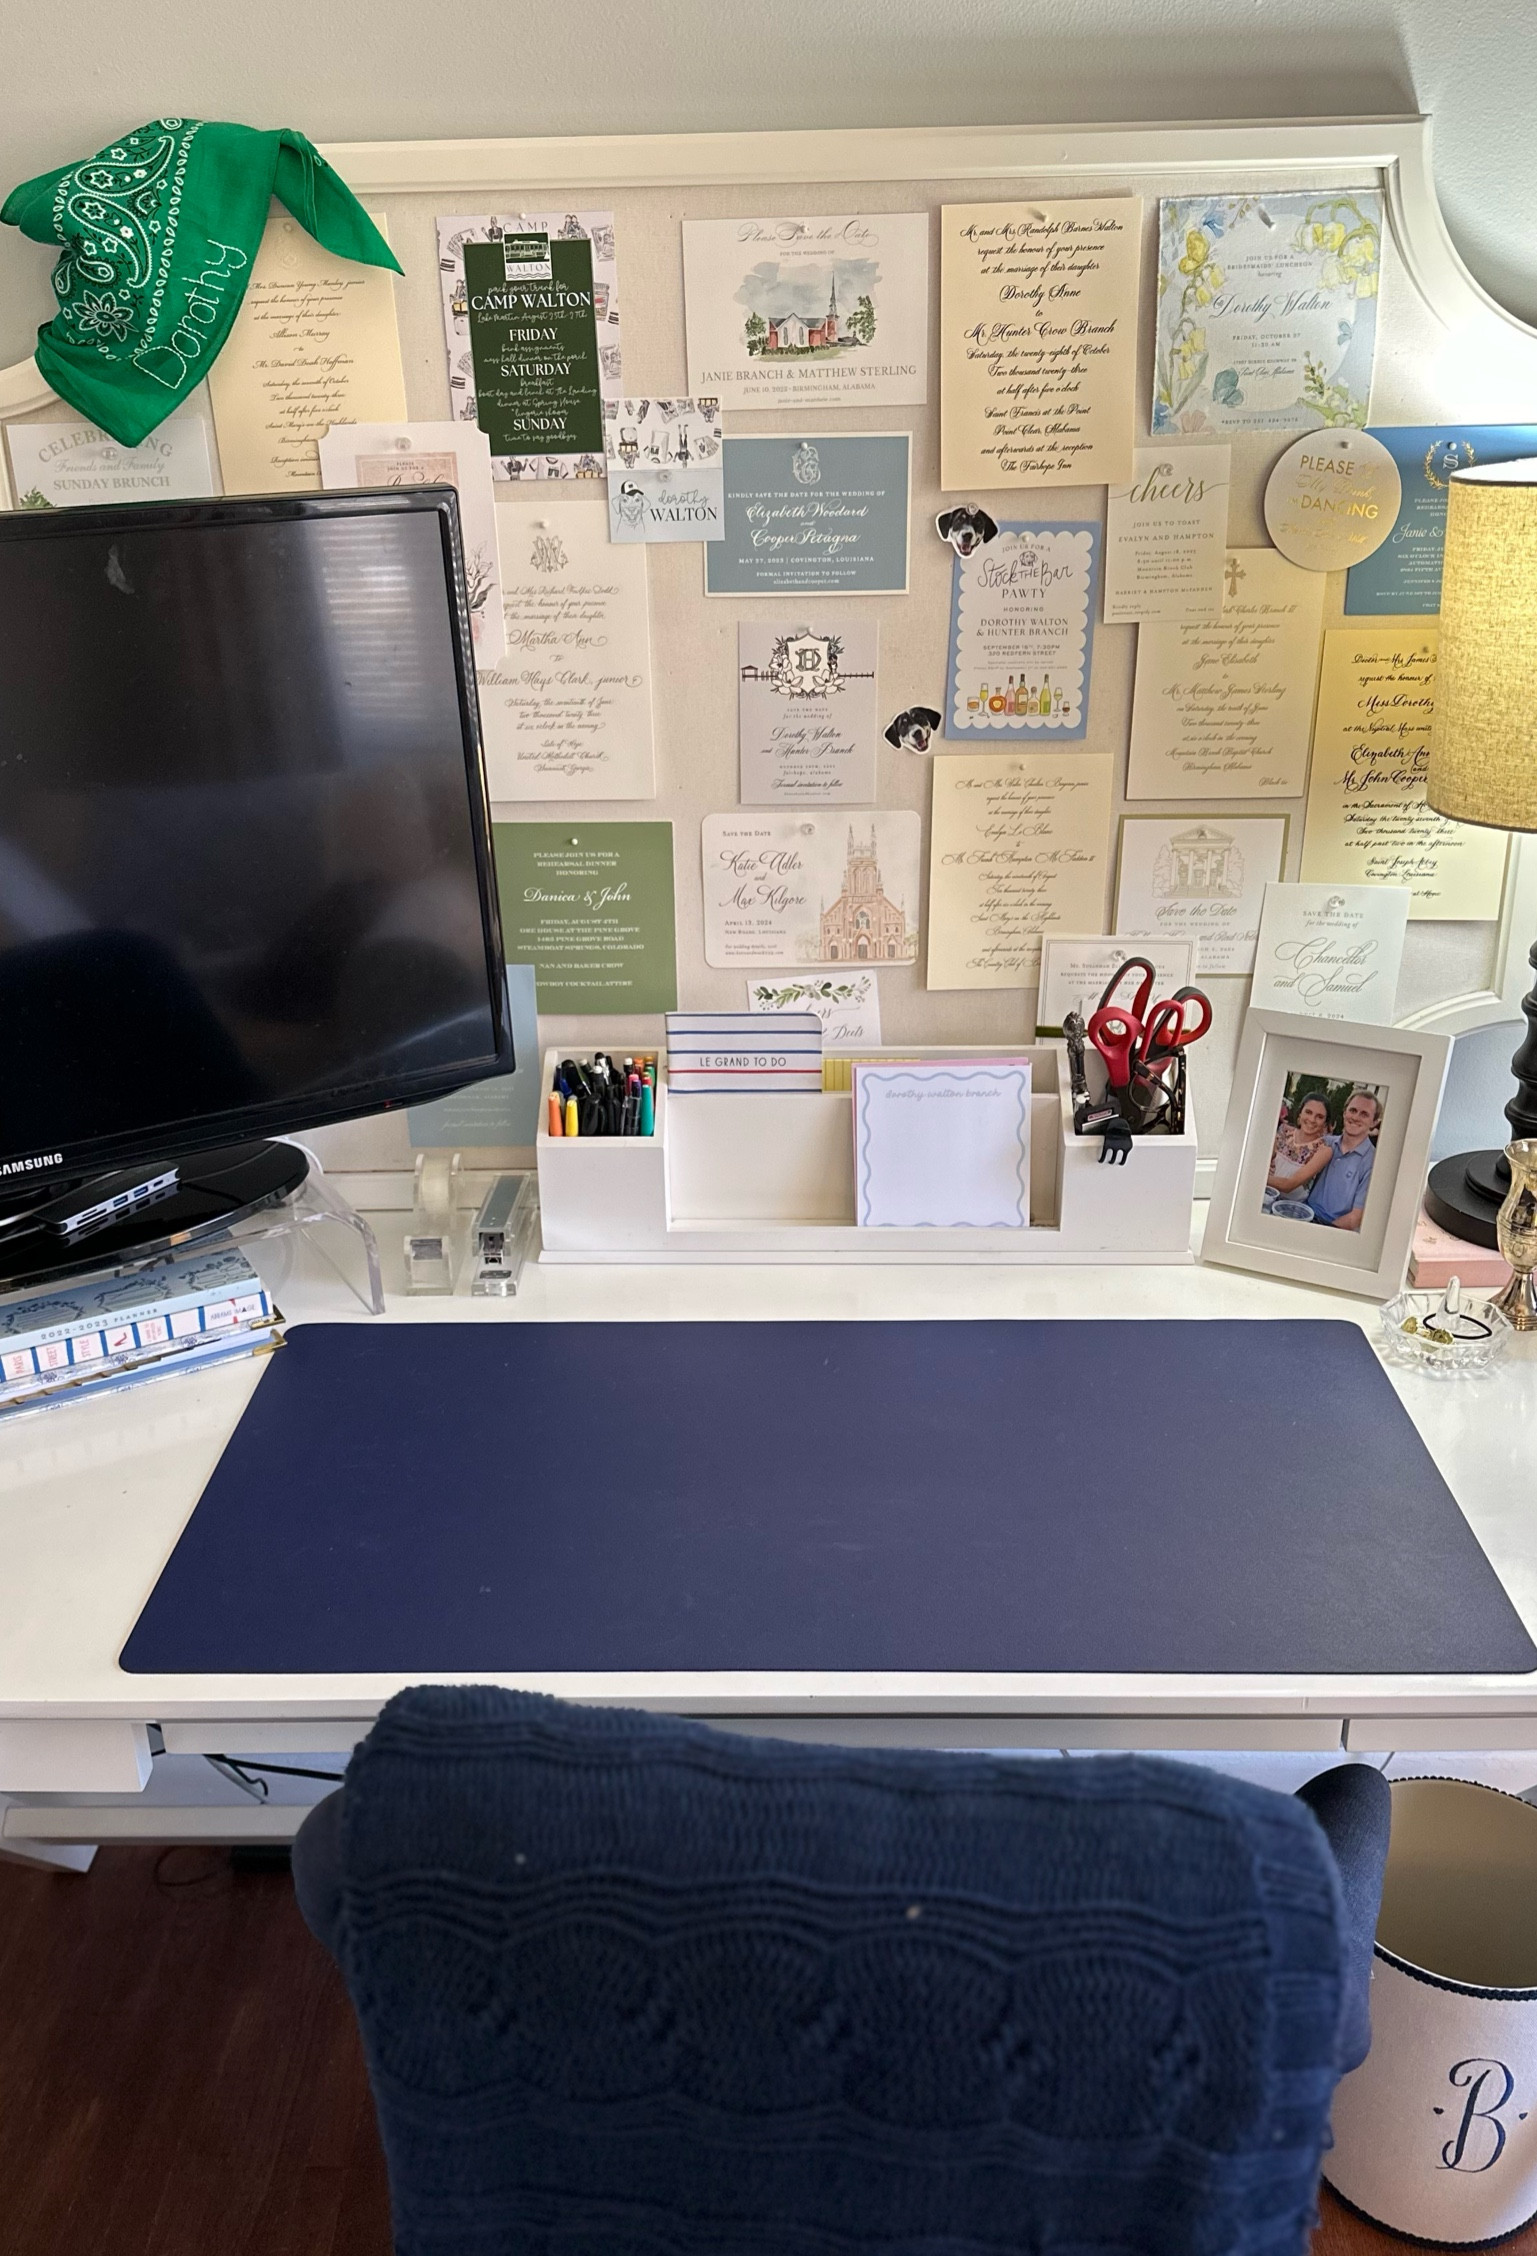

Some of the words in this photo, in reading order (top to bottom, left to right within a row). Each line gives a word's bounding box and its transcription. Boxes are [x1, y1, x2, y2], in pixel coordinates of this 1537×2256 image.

[503, 222, 548, 232] CAMP
[737, 222, 775, 242] Please
[816, 227, 832, 240] the
[1017, 222, 1059, 238] Randolph
[1061, 221, 1092, 234] Barnes
[978, 247, 1003, 262] request
[1006, 245, 1018, 254] the
[1046, 242, 1058, 258] of
[1055, 245, 1073, 259] your
[1074, 244, 1105, 257] presence
[507, 264, 551, 272] WALTON
[981, 266, 990, 274] at
[993, 264, 1005, 273] the
[1040, 262, 1049, 278] of
[1050, 261, 1066, 271] their
[1068, 259, 1100, 277] daughter
[471, 295, 518, 311] CAMP
[521, 292, 591, 308] WALTON
[999, 284, 1046, 307] Dorothy
[1049, 283, 1082, 301] Anne
[1209, 293, 1274, 323] Dorothy
[1274, 291, 1331, 317] Walton
[509, 328, 558, 342] FRIDAY
[988, 322, 1032, 342] Hunter
[1033, 321, 1067, 339] Crow
[1070, 319, 1118, 337] Branch
[501, 363, 572, 377] SATURDAY
[701, 370, 733, 384] JANIE
[736, 369, 783, 381] BRANCH
[786, 369, 795, 379] &
[798, 367, 858, 378] MATTHEW
[860, 365, 917, 376] STERLING
[743, 386, 760, 395] JUNE
[985, 407, 1007, 419] Saint
[1009, 406, 1041, 420] Francis
[1042, 408, 1051, 416] at
[1053, 407, 1064, 416] the
[1066, 404, 1091, 416] Point
[513, 418, 568, 431] SUNDAY
[1044, 423, 1081, 436] Alabama
[54, 459, 97, 472] Friends
[100, 460, 122, 471] and
[122, 457, 165, 474] Family
[1001, 459, 1017, 472] The
[1300, 455, 1355, 475] PLEASE
[53, 479, 111, 490] SUNDAY
[113, 476, 170, 488] BRUNCH
[658, 489, 708, 506] dorothy
[650, 507, 718, 522] WALTON
[746, 502, 808, 527] Elizabeth
[808, 500, 869, 518] Woodard
[750, 529, 796, 552] Cooper
[1392, 523, 1427, 544] Janie
[1431, 527, 1444, 537] &
[978, 557, 1018, 588] Stock
[1018, 569, 1039, 580] THE
[1040, 559, 1073, 586] Bar
[1002, 588, 1047, 598] PAWTY
[981, 618, 1026, 627] DOROTHY
[1031, 618, 1068, 626] WALTON
[507, 629, 560, 652] Martha
[976, 629, 985, 637] &
[987, 628, 1026, 636] HUNTER
[476, 670, 520, 686] William
[521, 670, 551, 691] Hays
[1358, 695, 1388, 717] Miss
[770, 727, 807, 744] Dorothy
[1351, 744, 1408, 766] Elizabeth
[1358, 769, 1391, 791] John
[720, 850, 758, 877] Katie
[759, 850, 804, 875] Adler
[754, 873, 767, 881] and
[523, 887, 580, 902] Danica
[584, 891, 597, 906] &
[592, 882, 631, 911] John
[757, 885, 806, 913] Kilgore
[1156, 902, 1186, 921] Save
[1189, 904, 1206, 916] the
[1210, 903, 1237, 916] Date
[1274, 972, 1305, 987] and
[1298, 966, 1378, 1006] Samuel
[700, 1057, 711, 1067] LE
[715, 1057, 750, 1067] GRAND
[754, 1057, 767, 1067] TO
[771, 1057, 786, 1066] DO
[886, 1090, 924, 1101] dorothy
[965, 1089, 1001, 1097] branch
[41, 1320, 108, 1340] 2022-2023
[114, 1309, 157, 1322] PLANNER
